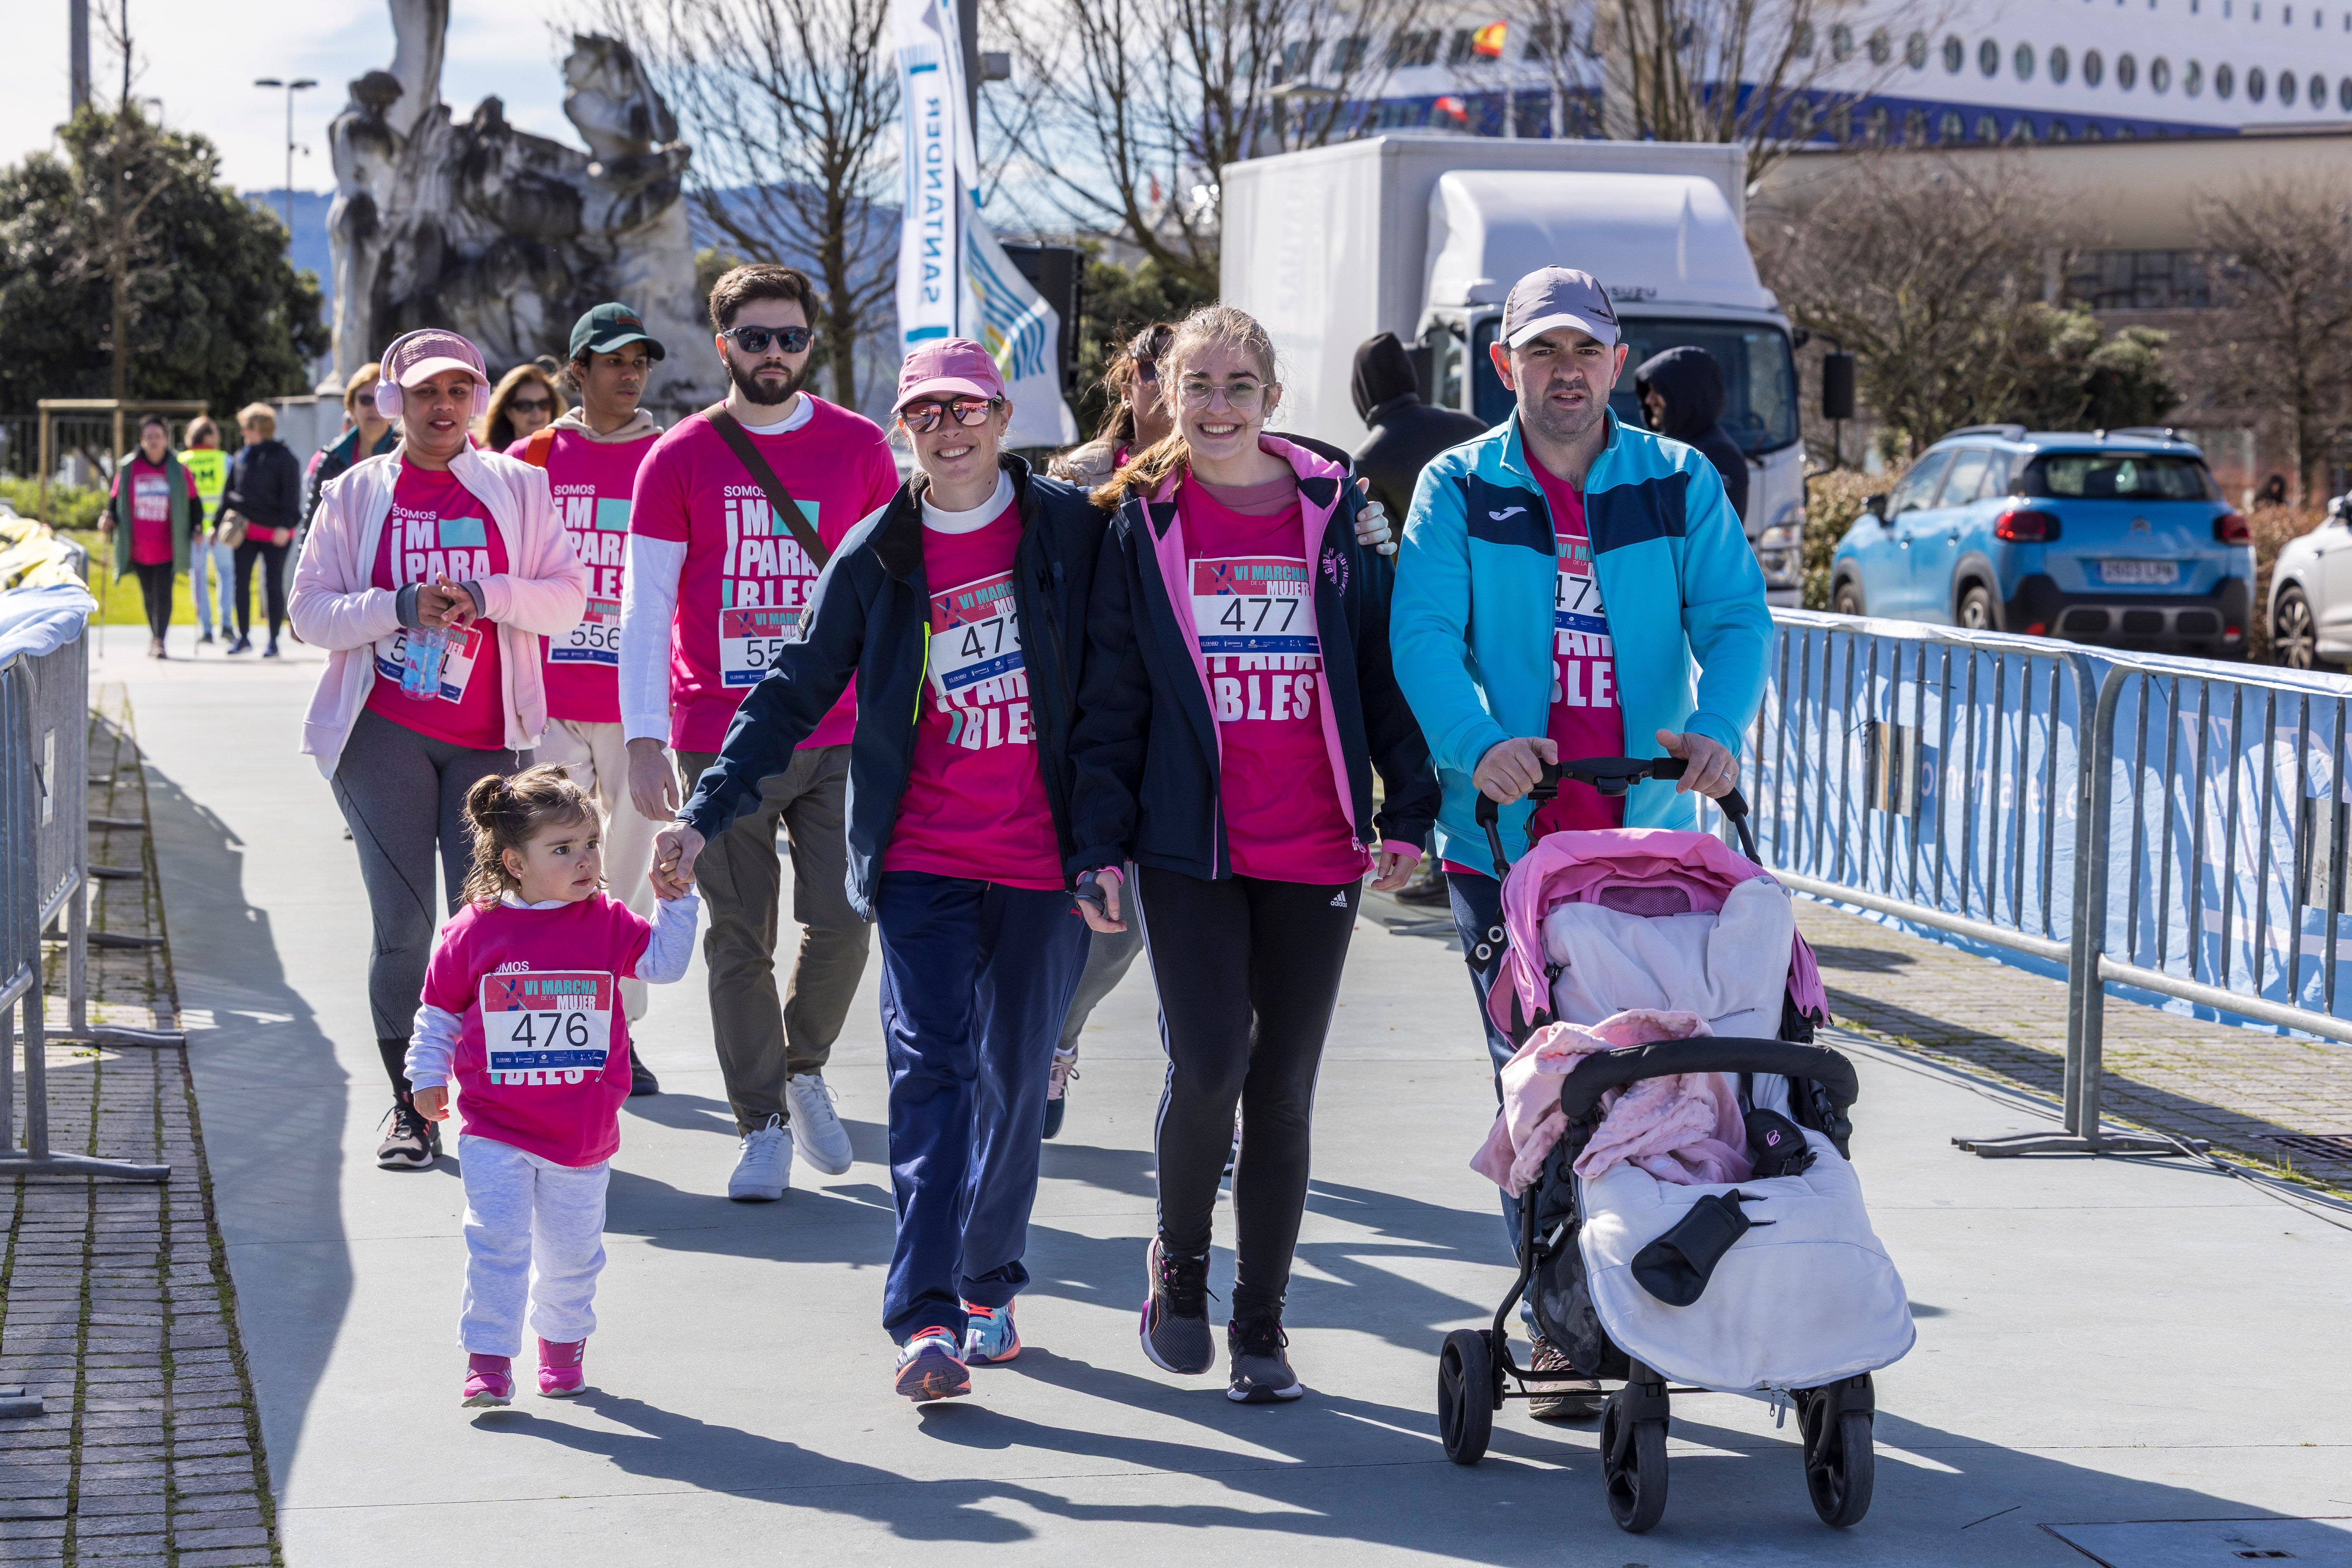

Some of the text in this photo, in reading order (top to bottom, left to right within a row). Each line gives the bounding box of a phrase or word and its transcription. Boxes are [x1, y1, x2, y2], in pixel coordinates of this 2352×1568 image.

[554, 484, 595, 495] SOMOS
[724, 485, 767, 497] SOMOS
[392, 506, 436, 520] SOMOS
[566, 531, 628, 566] PAR
[1558, 543, 1572, 558] VI
[405, 550, 491, 585] PARA
[1234, 565, 1309, 582] VI MARCHA
[1335, 552, 1349, 597] AUTHENT
[1267, 581, 1312, 596] MUJER
[958, 593, 975, 610] VI
[755, 613, 766, 625] VI
[1220, 598, 1299, 632] 477
[570, 623, 620, 650] 556
[746, 639, 784, 667] 55
[1214, 674, 1314, 722] BLES
[524, 980, 597, 995] VI MARCHA
[556, 995, 596, 1011] MUJER
[511, 1012, 588, 1048] 476
